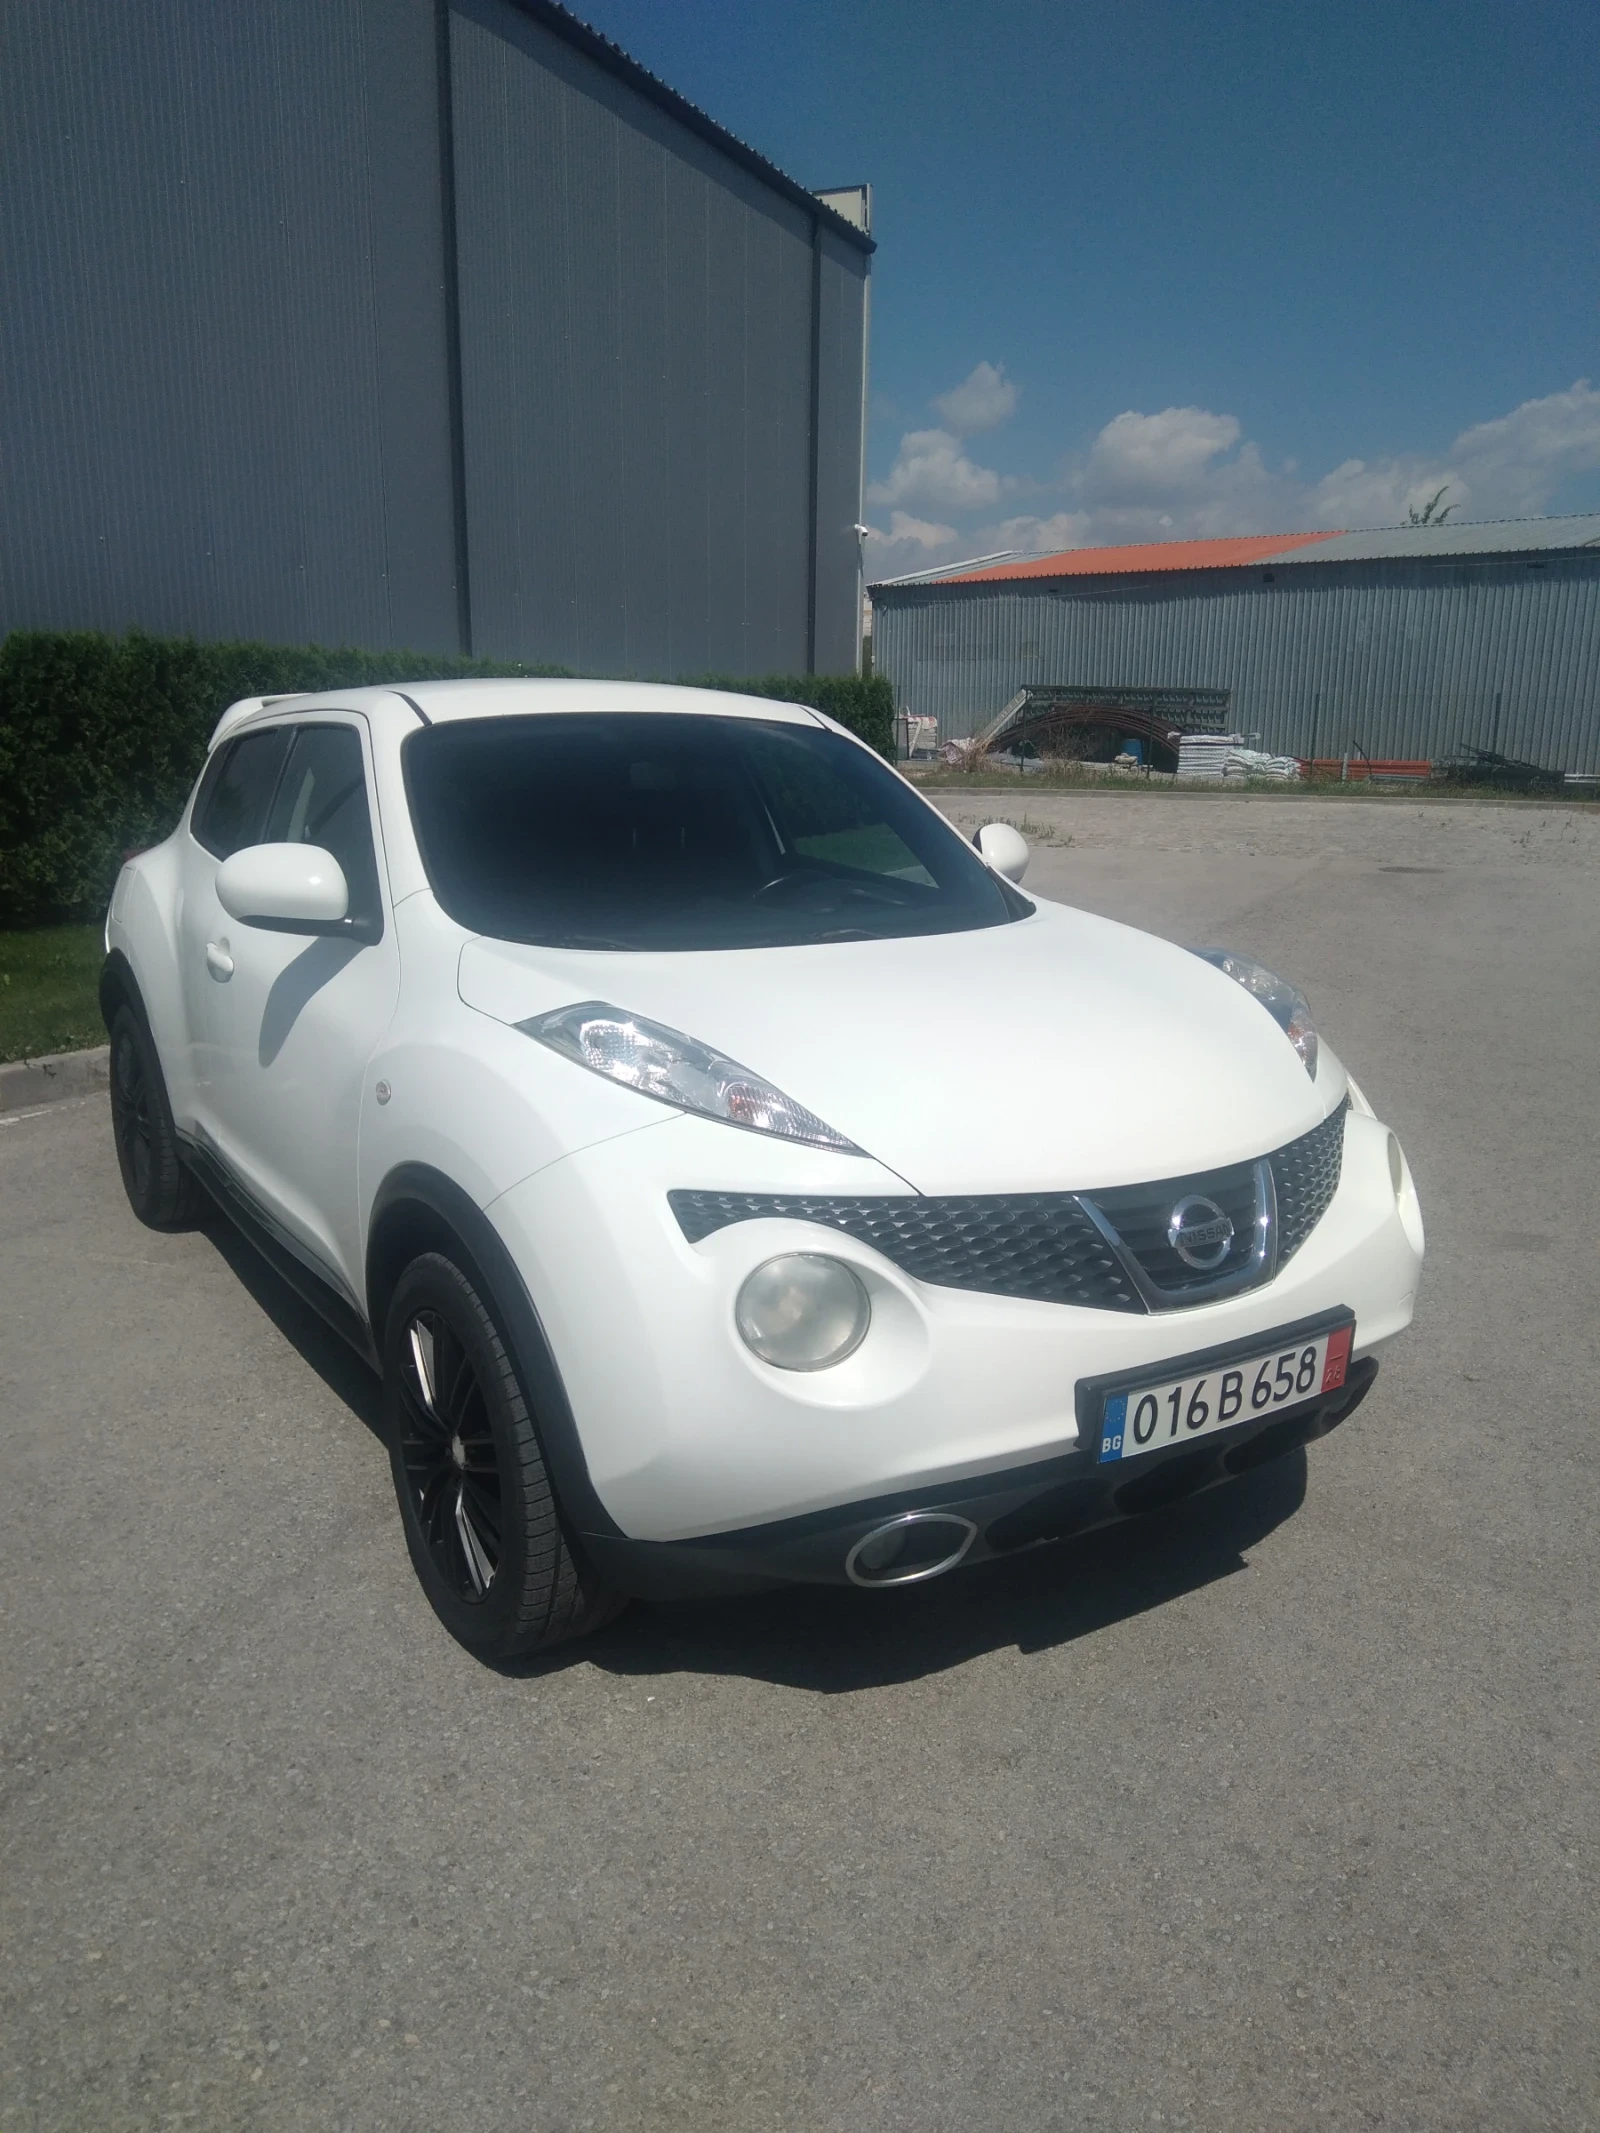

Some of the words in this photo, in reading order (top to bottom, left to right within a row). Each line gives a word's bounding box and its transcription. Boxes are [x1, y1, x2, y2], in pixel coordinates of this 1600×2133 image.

[1180, 1223, 1232, 1244] NISSAN
[1133, 1346, 1317, 1445] 016B658
[1101, 1434, 1122, 1454] BG
